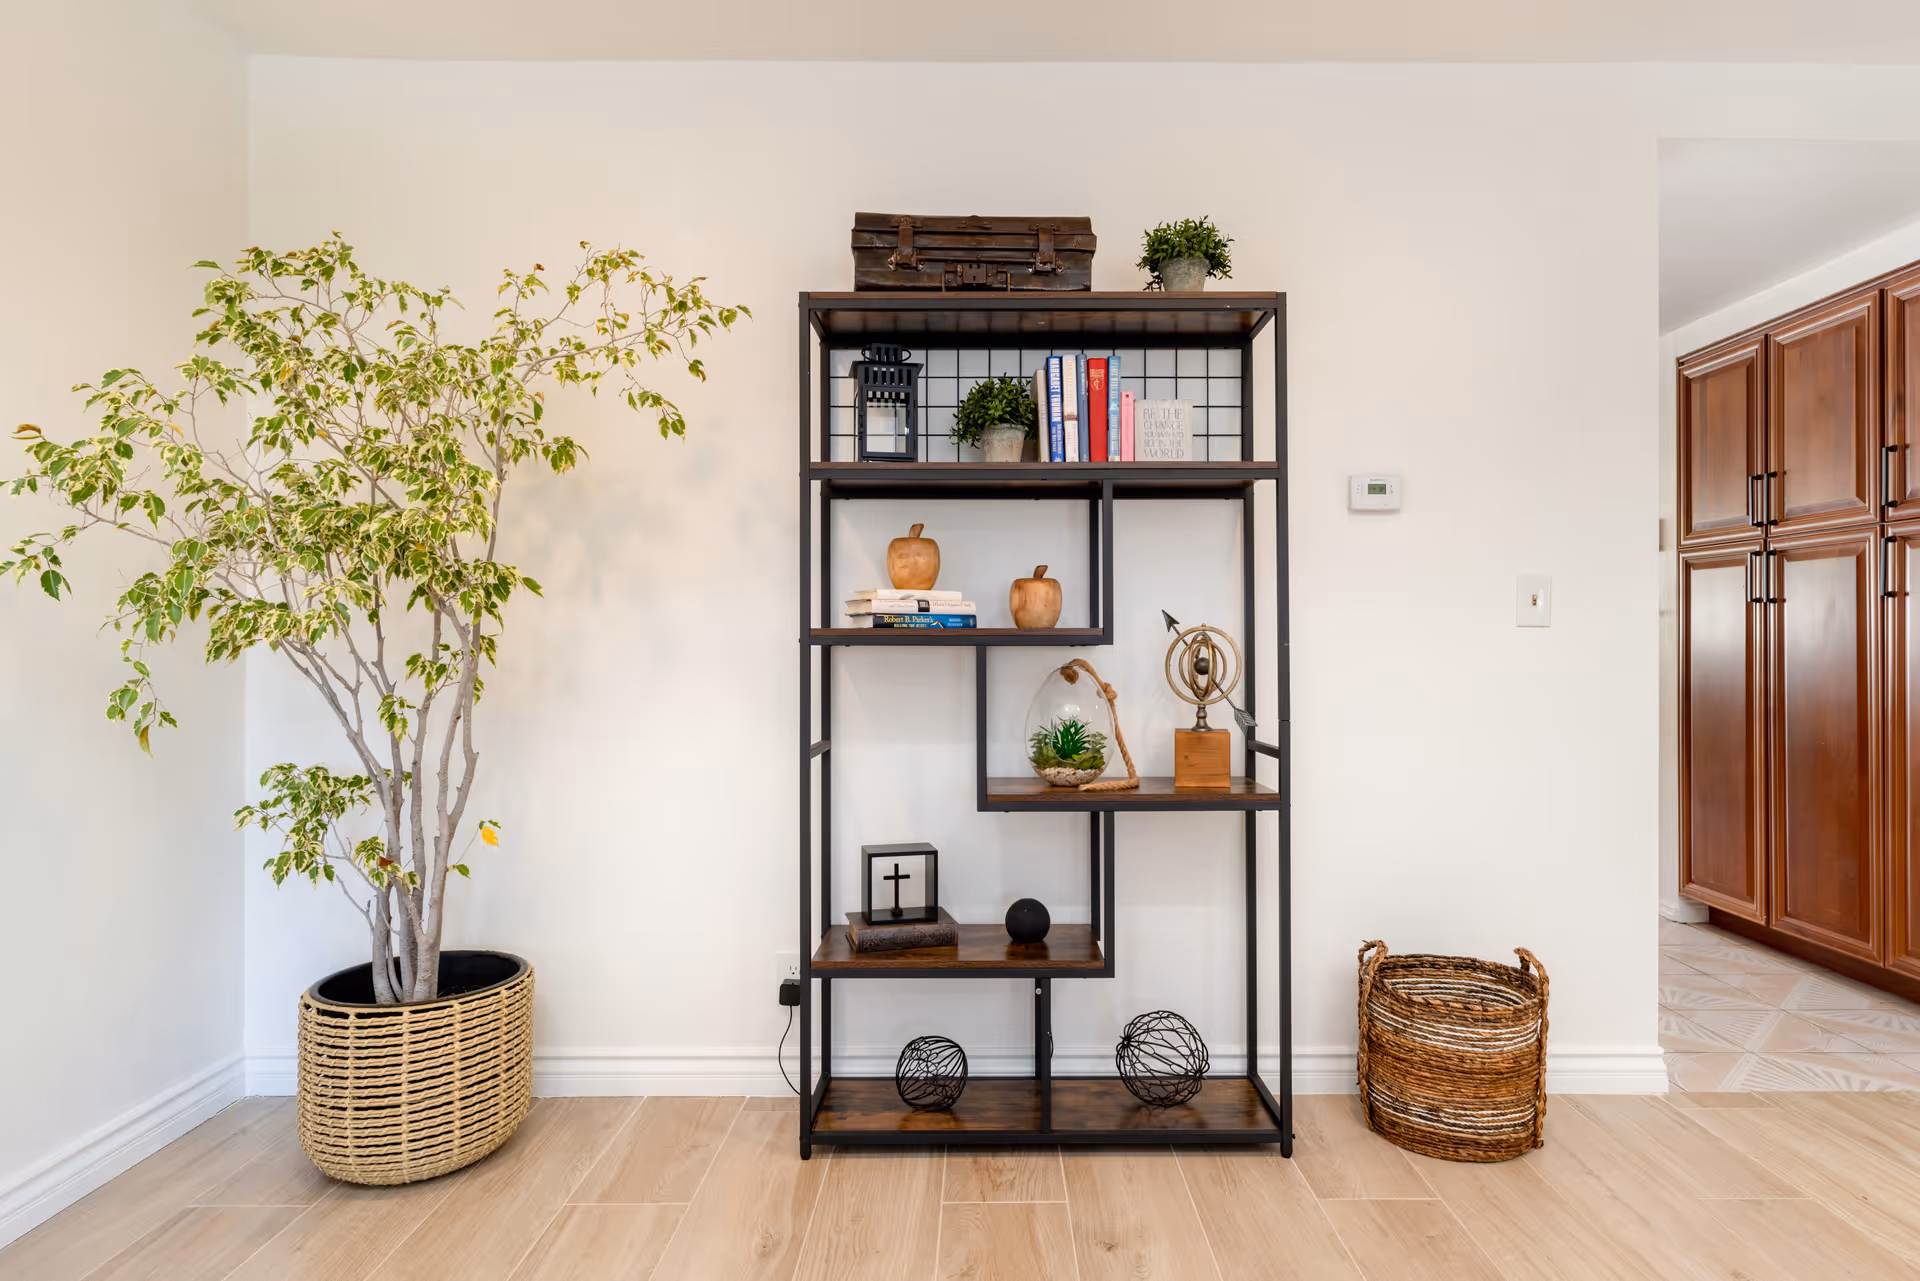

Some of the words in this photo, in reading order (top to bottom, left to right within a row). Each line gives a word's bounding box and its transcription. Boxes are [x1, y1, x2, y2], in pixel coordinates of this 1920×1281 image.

[1050, 358, 1060, 392] MARGARET
[1052, 394, 1061, 422] TRUMAN
[1160, 408, 1184, 419] THE
[1143, 420, 1184, 430] CHANGE
[1143, 448, 1184, 459] WORLD
[884, 615, 904, 623] Robert
[904, 615, 912, 623] B.
[912, 615, 933, 623] Parker's
